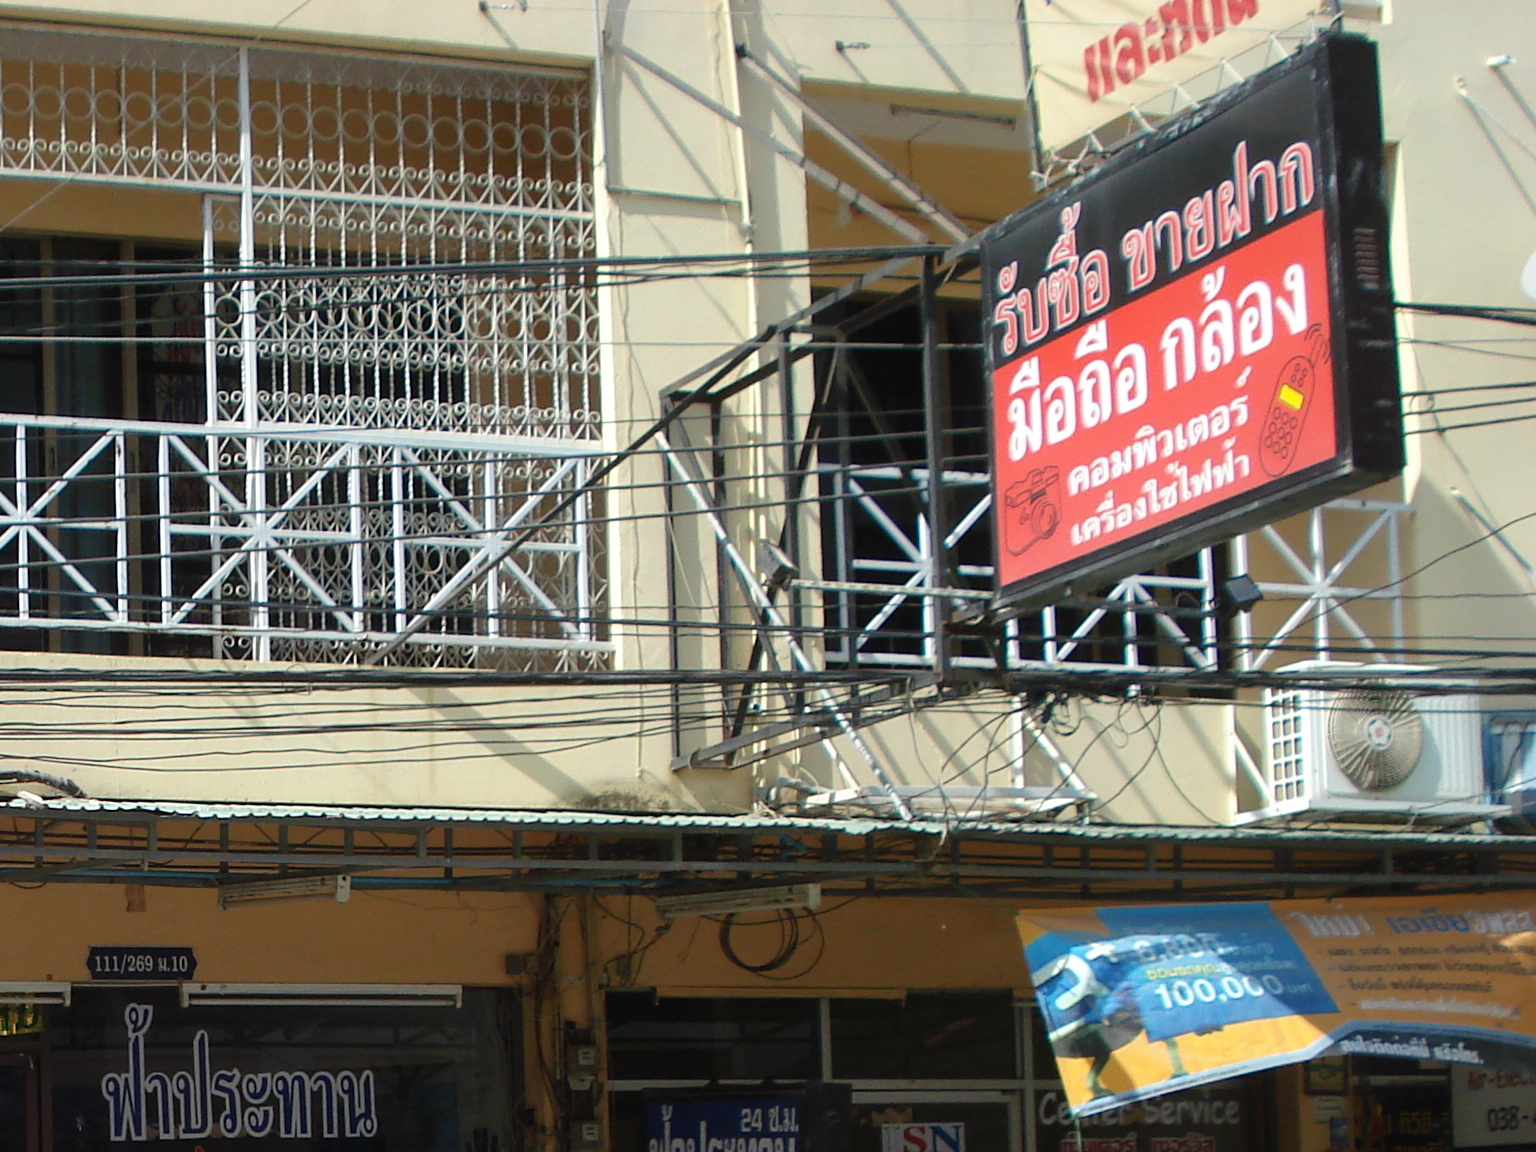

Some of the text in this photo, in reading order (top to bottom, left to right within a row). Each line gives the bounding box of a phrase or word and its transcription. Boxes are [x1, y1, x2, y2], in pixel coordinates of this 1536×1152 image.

[992, 139, 1315, 356] รับซื้อ ขายฝาก
[1008, 264, 1307, 461] มือถือ กล้อง
[1067, 366, 1250, 495] คอมพิวเตอร์
[1070, 435, 1250, 546] เครื่องใช้ไฟฟ้า
[95, 955, 188, 974] 111/269 ม.10
[1154, 974, 1284, 1010] 100,000
[102, 1003, 378, 1142] ฟ้าประทาน
[740, 1107, 763, 1134] 24
[1039, 1092, 1245, 1126] Ceer Service
